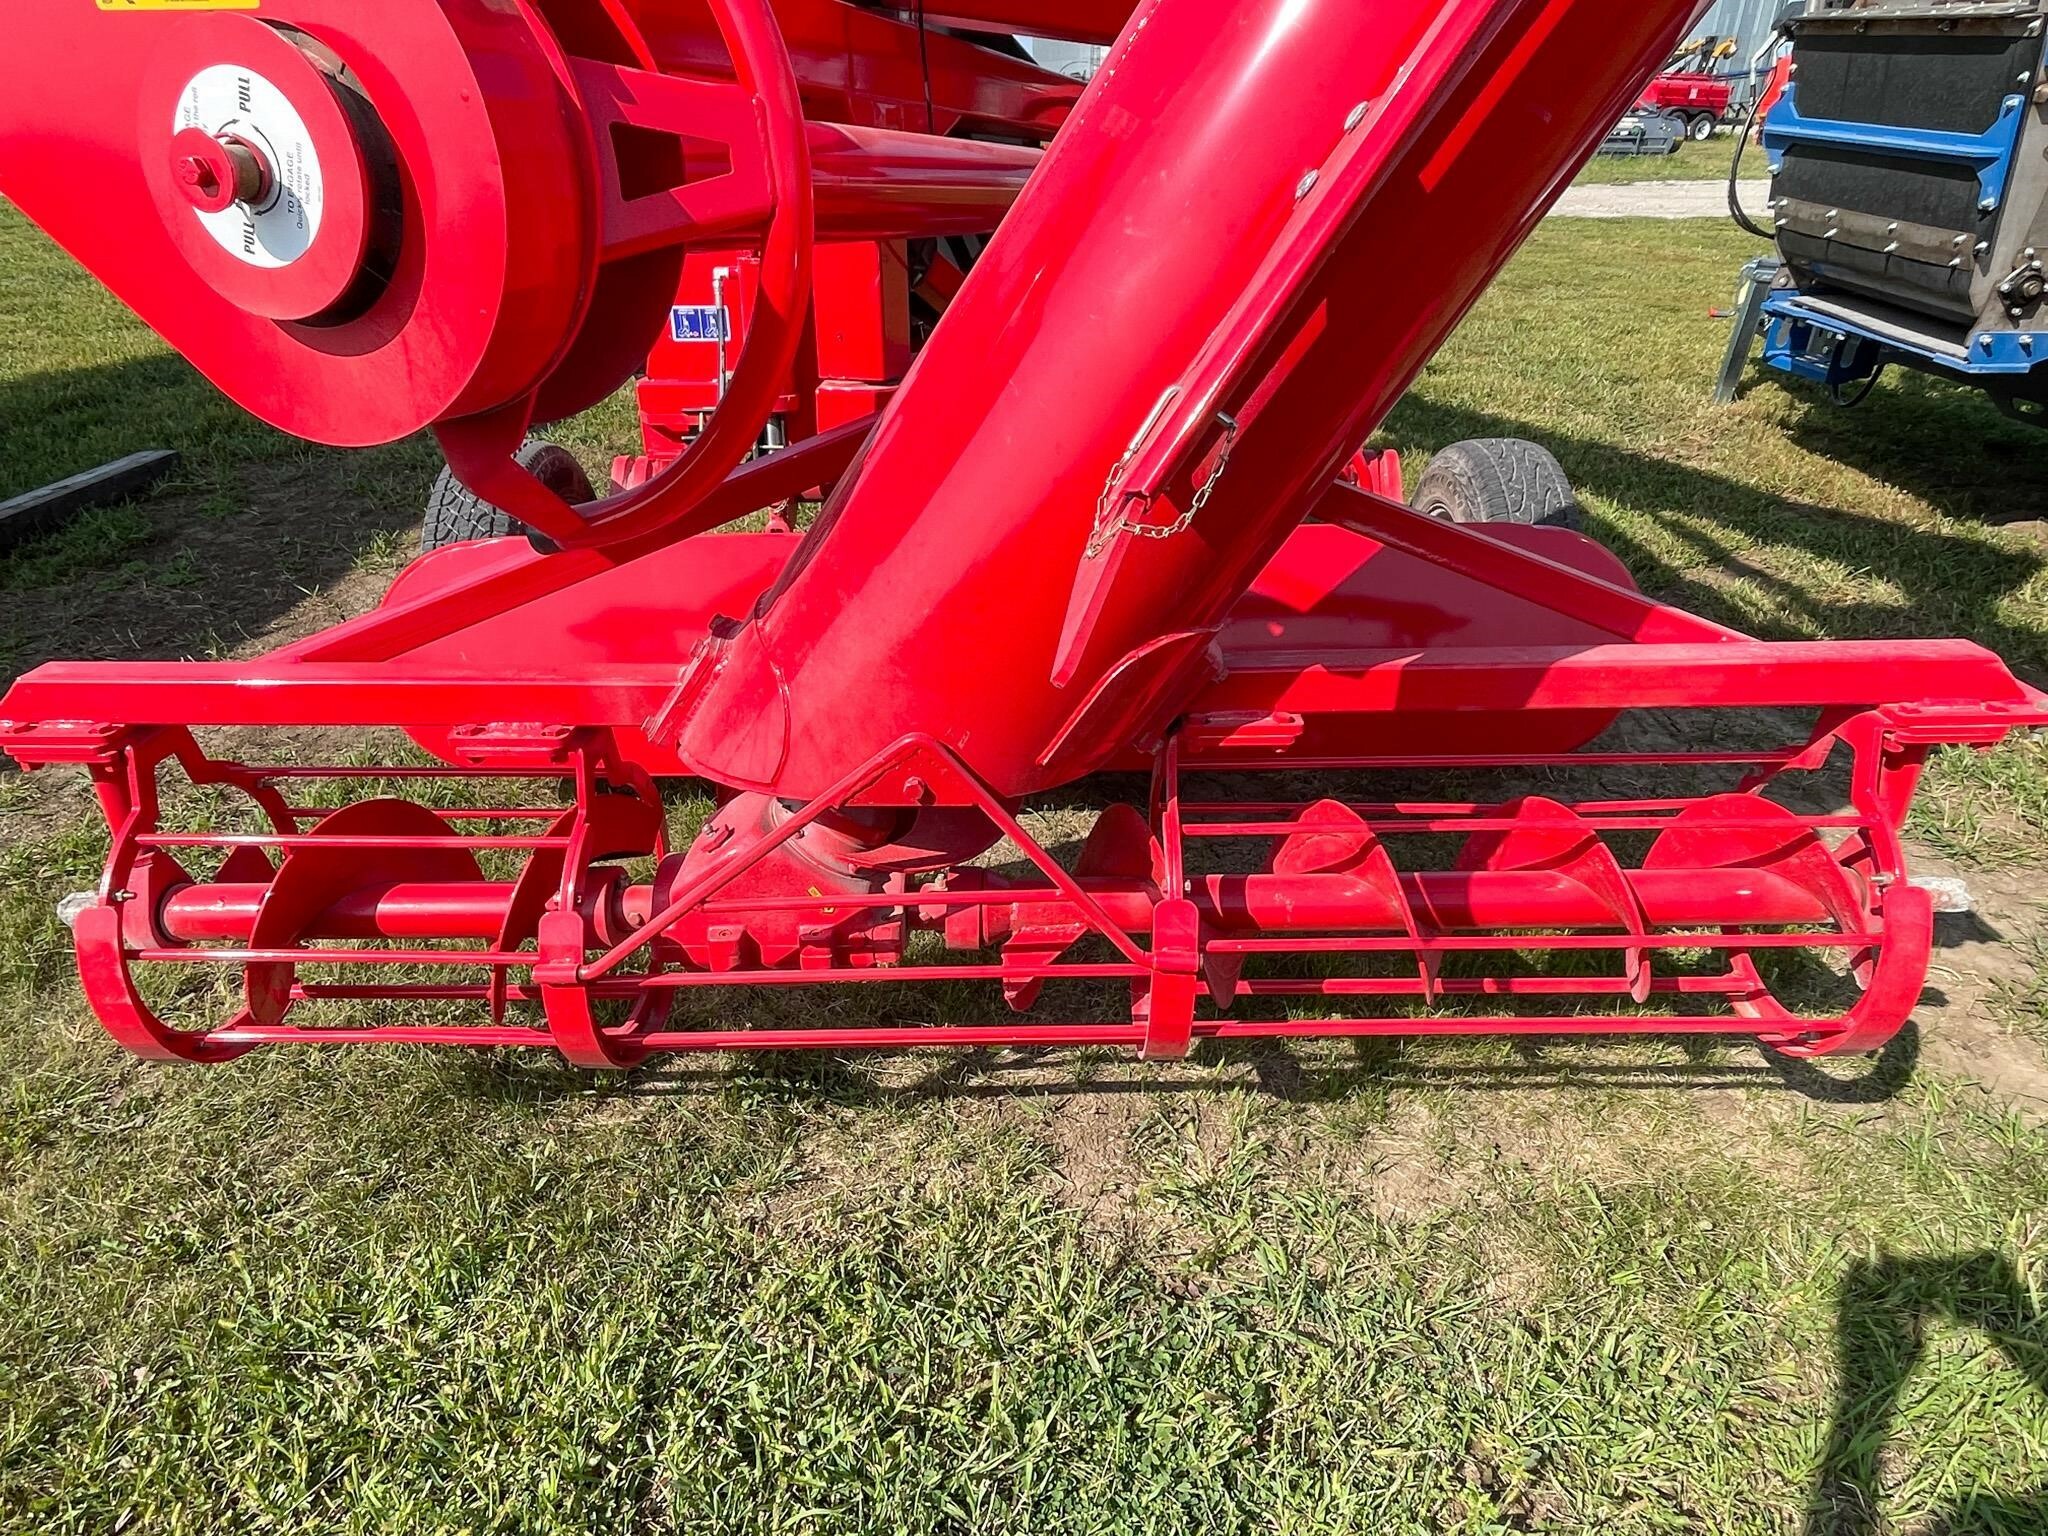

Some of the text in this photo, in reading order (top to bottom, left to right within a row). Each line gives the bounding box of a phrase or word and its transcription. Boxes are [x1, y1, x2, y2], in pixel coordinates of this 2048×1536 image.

[238, 77, 251, 113] PULL
[286, 152, 295, 214] TO ENGAGE
[244, 222, 255, 255] PULL
